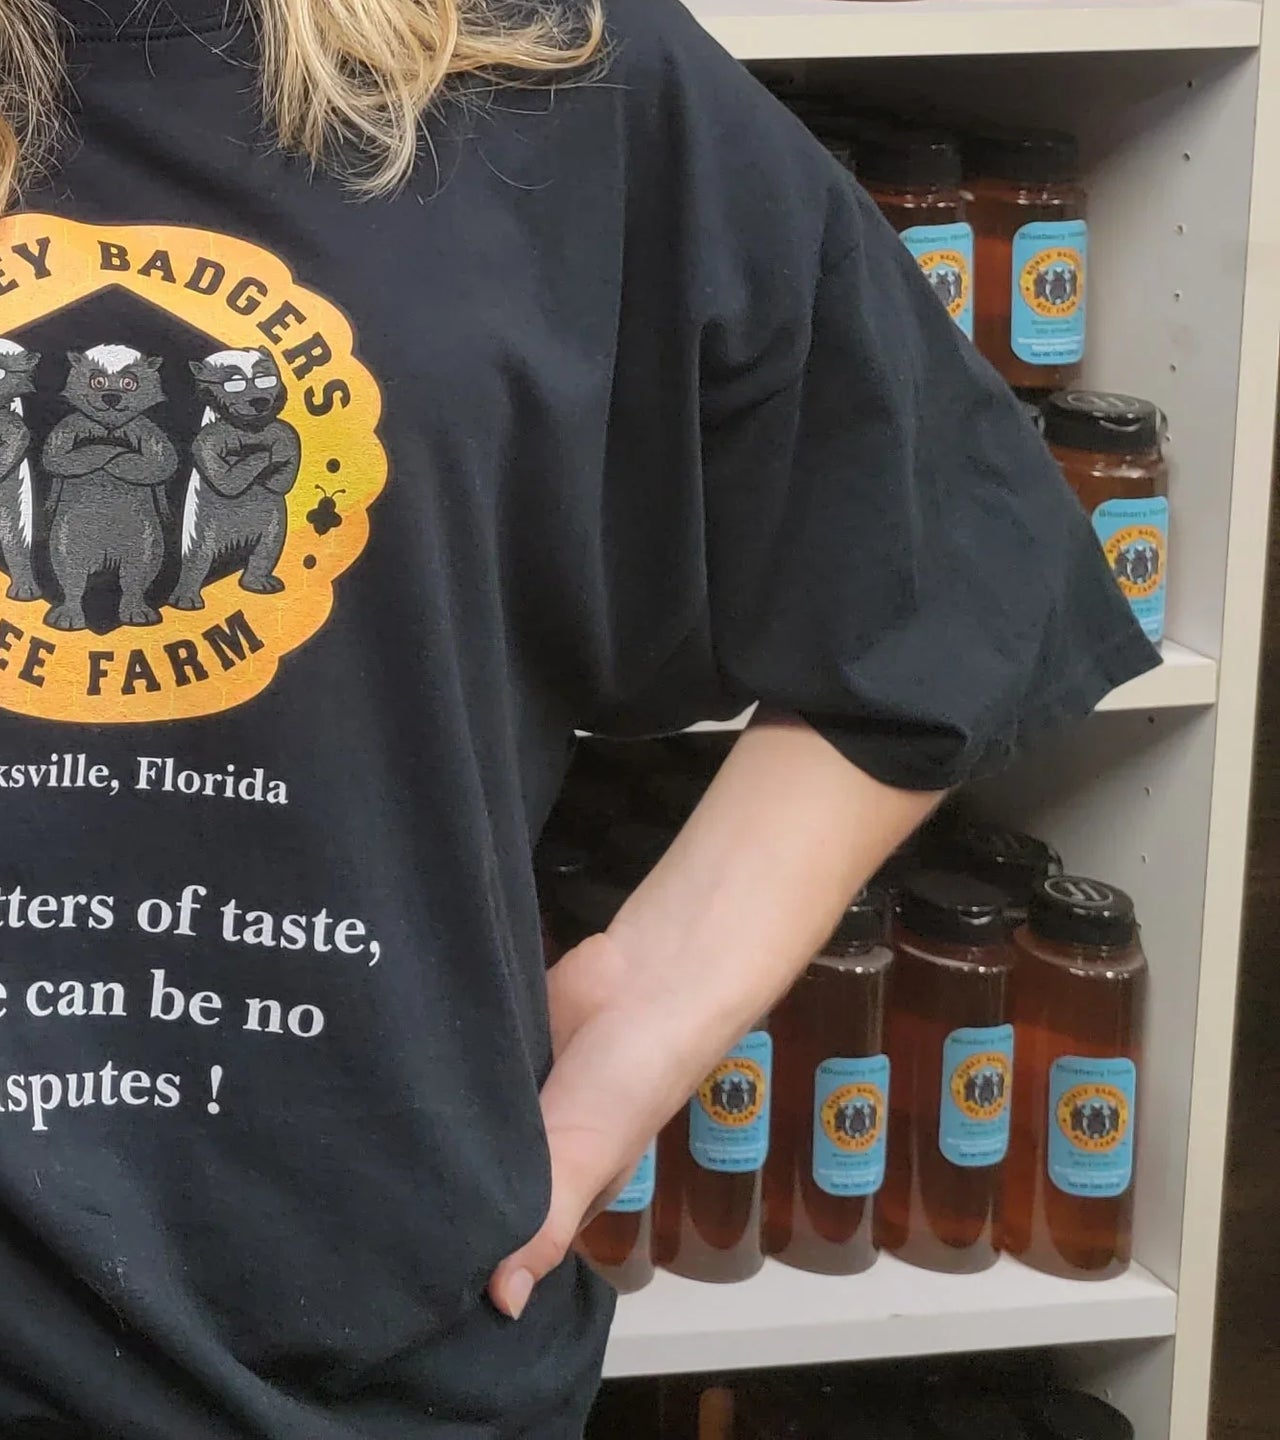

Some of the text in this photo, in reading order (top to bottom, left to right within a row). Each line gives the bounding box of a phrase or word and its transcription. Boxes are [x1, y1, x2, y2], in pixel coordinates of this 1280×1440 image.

[96, 238, 352, 417] BADGERS
[86, 608, 266, 696] FARM
[136, 758, 289, 806] Florida
[137, 887, 204, 936] of
[221, 901, 382, 965] taste,
[24, 981, 126, 1017] can
[150, 969, 221, 1025] be
[244, 997, 326, 1039] no
[206, 1064, 221, 1115] !
